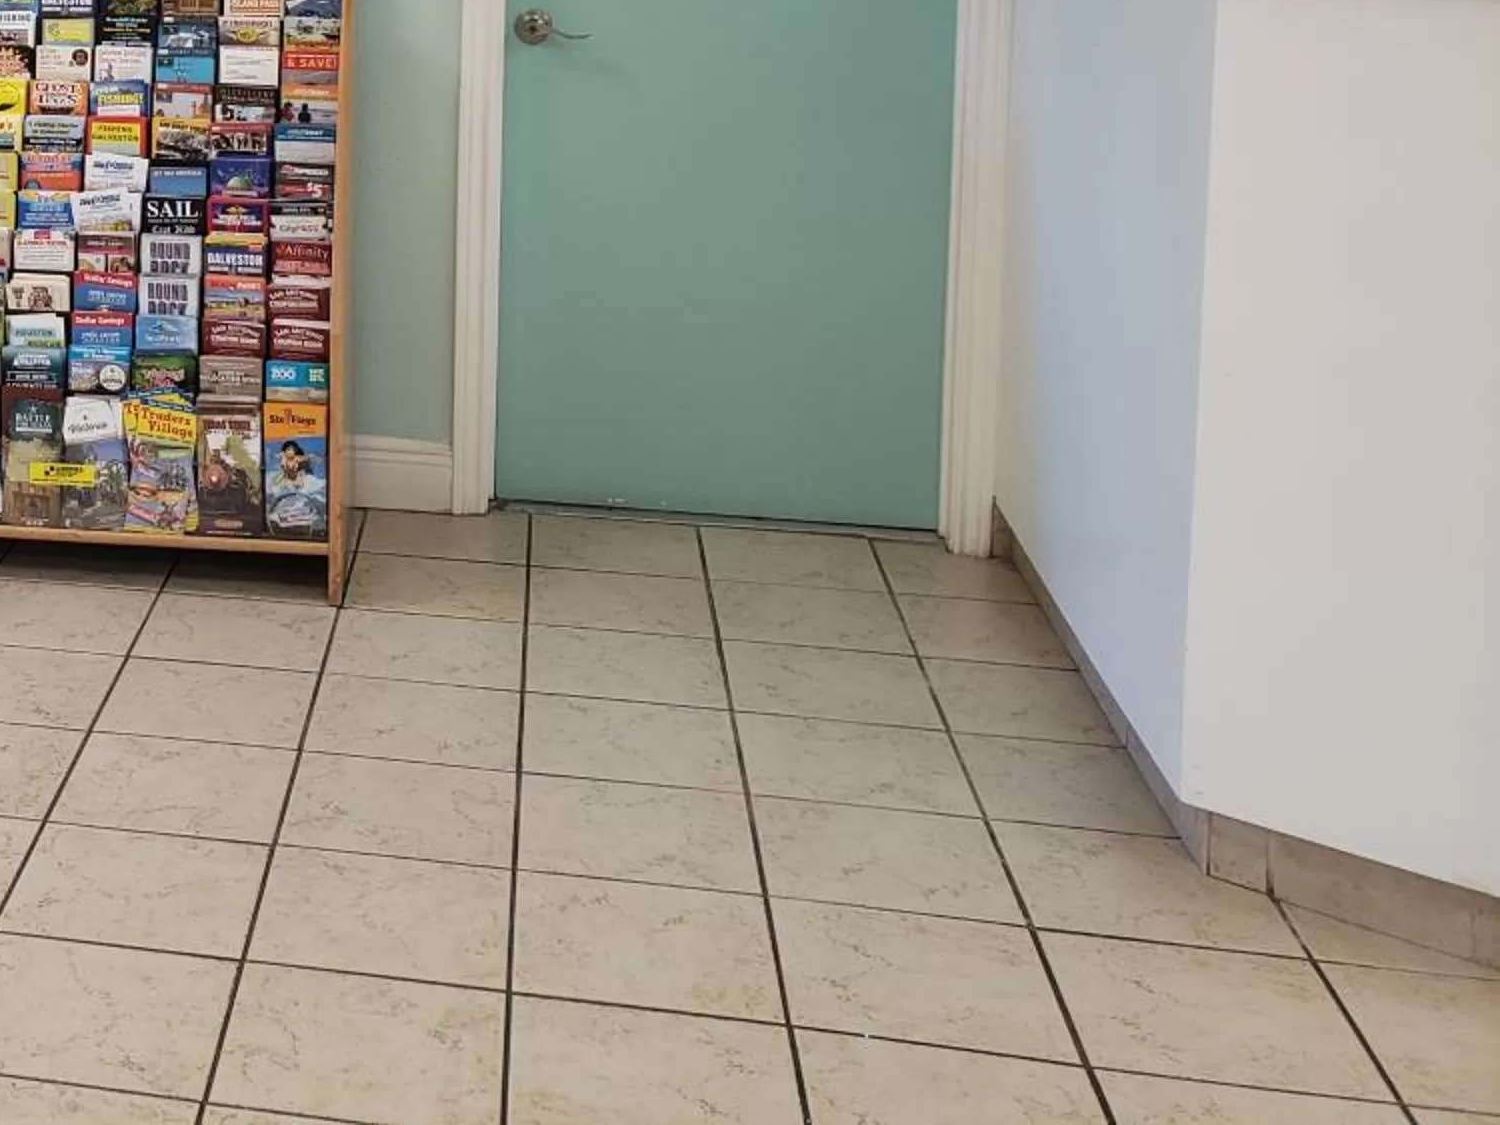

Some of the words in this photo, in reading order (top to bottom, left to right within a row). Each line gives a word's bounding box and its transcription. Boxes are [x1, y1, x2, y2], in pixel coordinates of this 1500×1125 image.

[146, 200, 199, 218] SAIL
[149, 241, 191, 260] ROUND
[286, 243, 329, 261] Affinity
[142, 409, 192, 425] Traders
[269, 414, 285, 424] Six
[291, 415, 317, 427] Flags
[148, 420, 193, 439] Village
